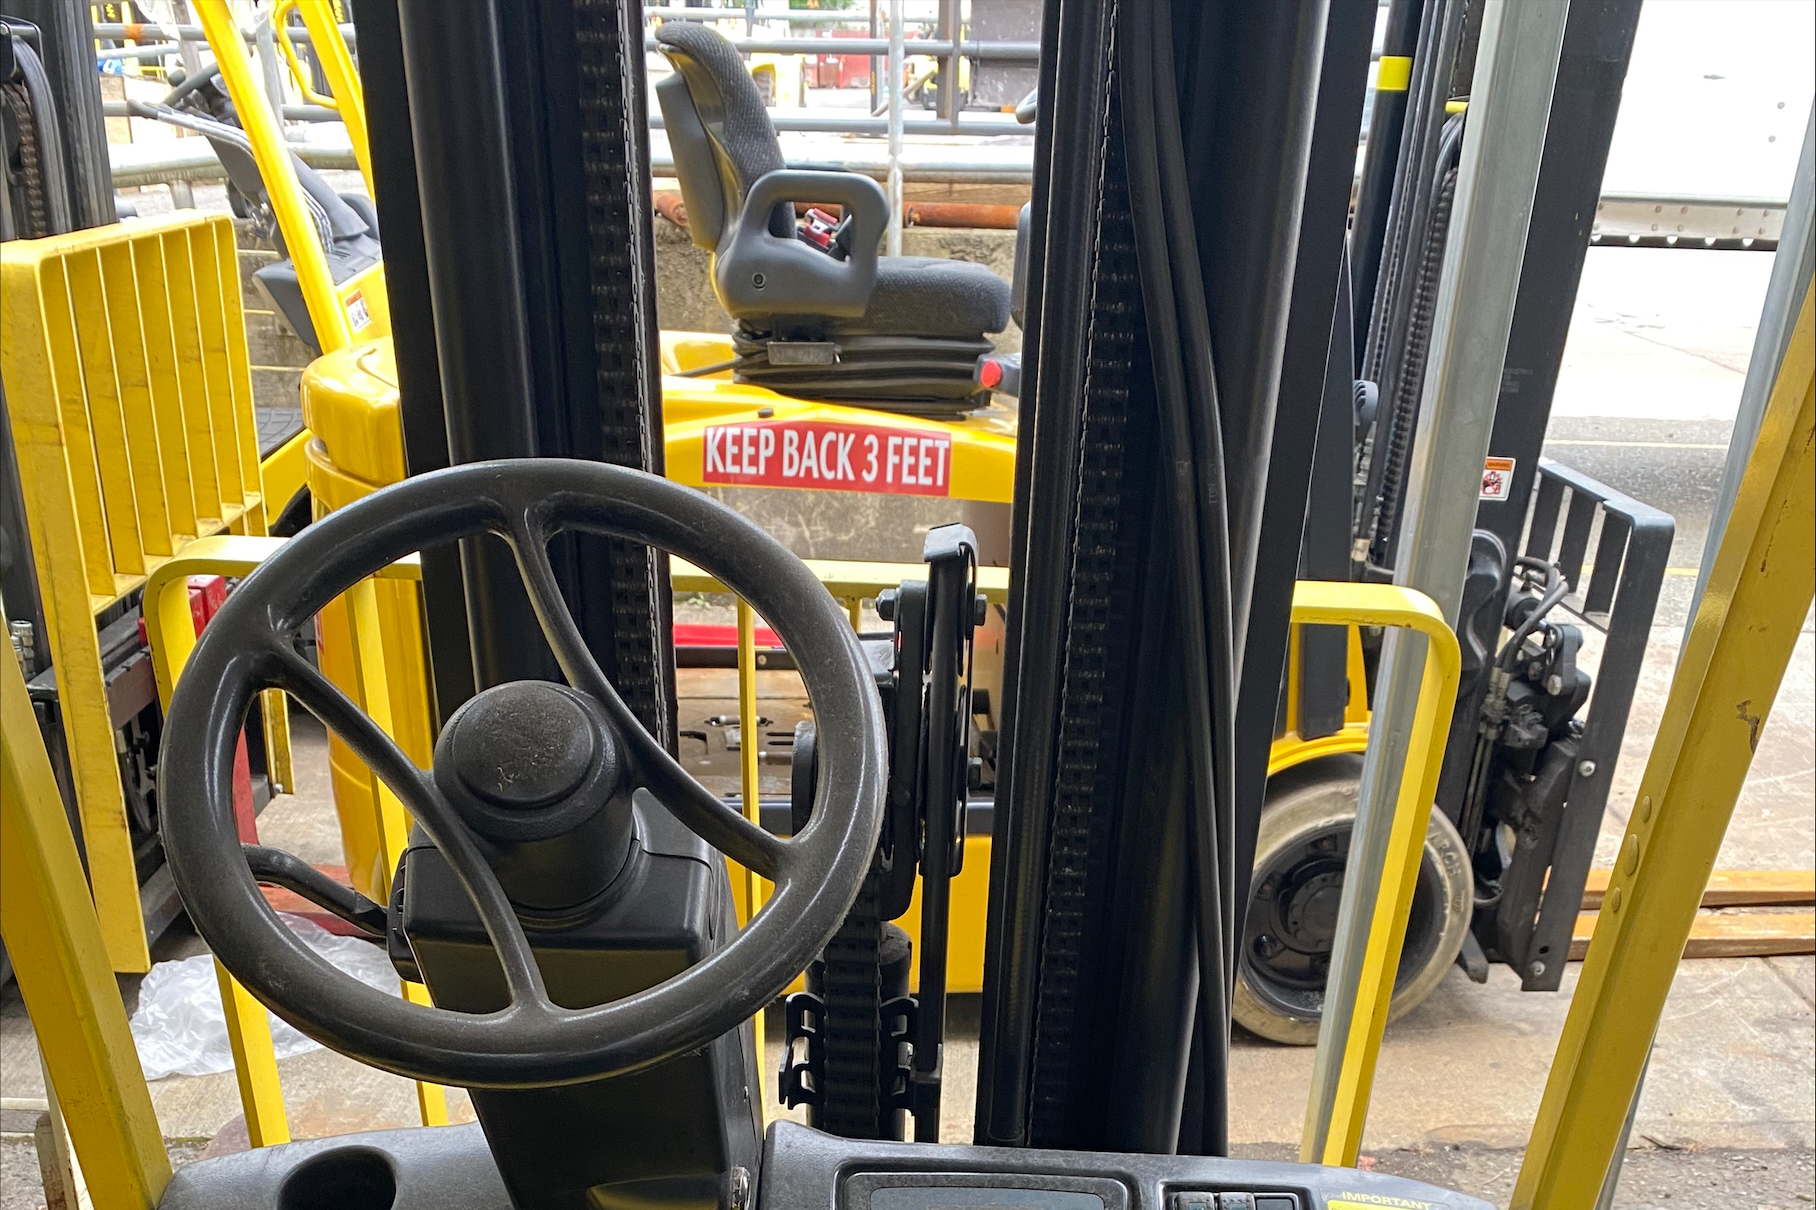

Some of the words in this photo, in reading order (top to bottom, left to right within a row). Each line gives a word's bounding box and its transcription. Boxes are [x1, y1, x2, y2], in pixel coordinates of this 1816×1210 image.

[706, 427, 775, 475] KEEP
[782, 429, 856, 481] BACK
[861, 434, 879, 482] 3
[885, 436, 949, 486] FEET
[1341, 1191, 1431, 1210] IMPORTANT
